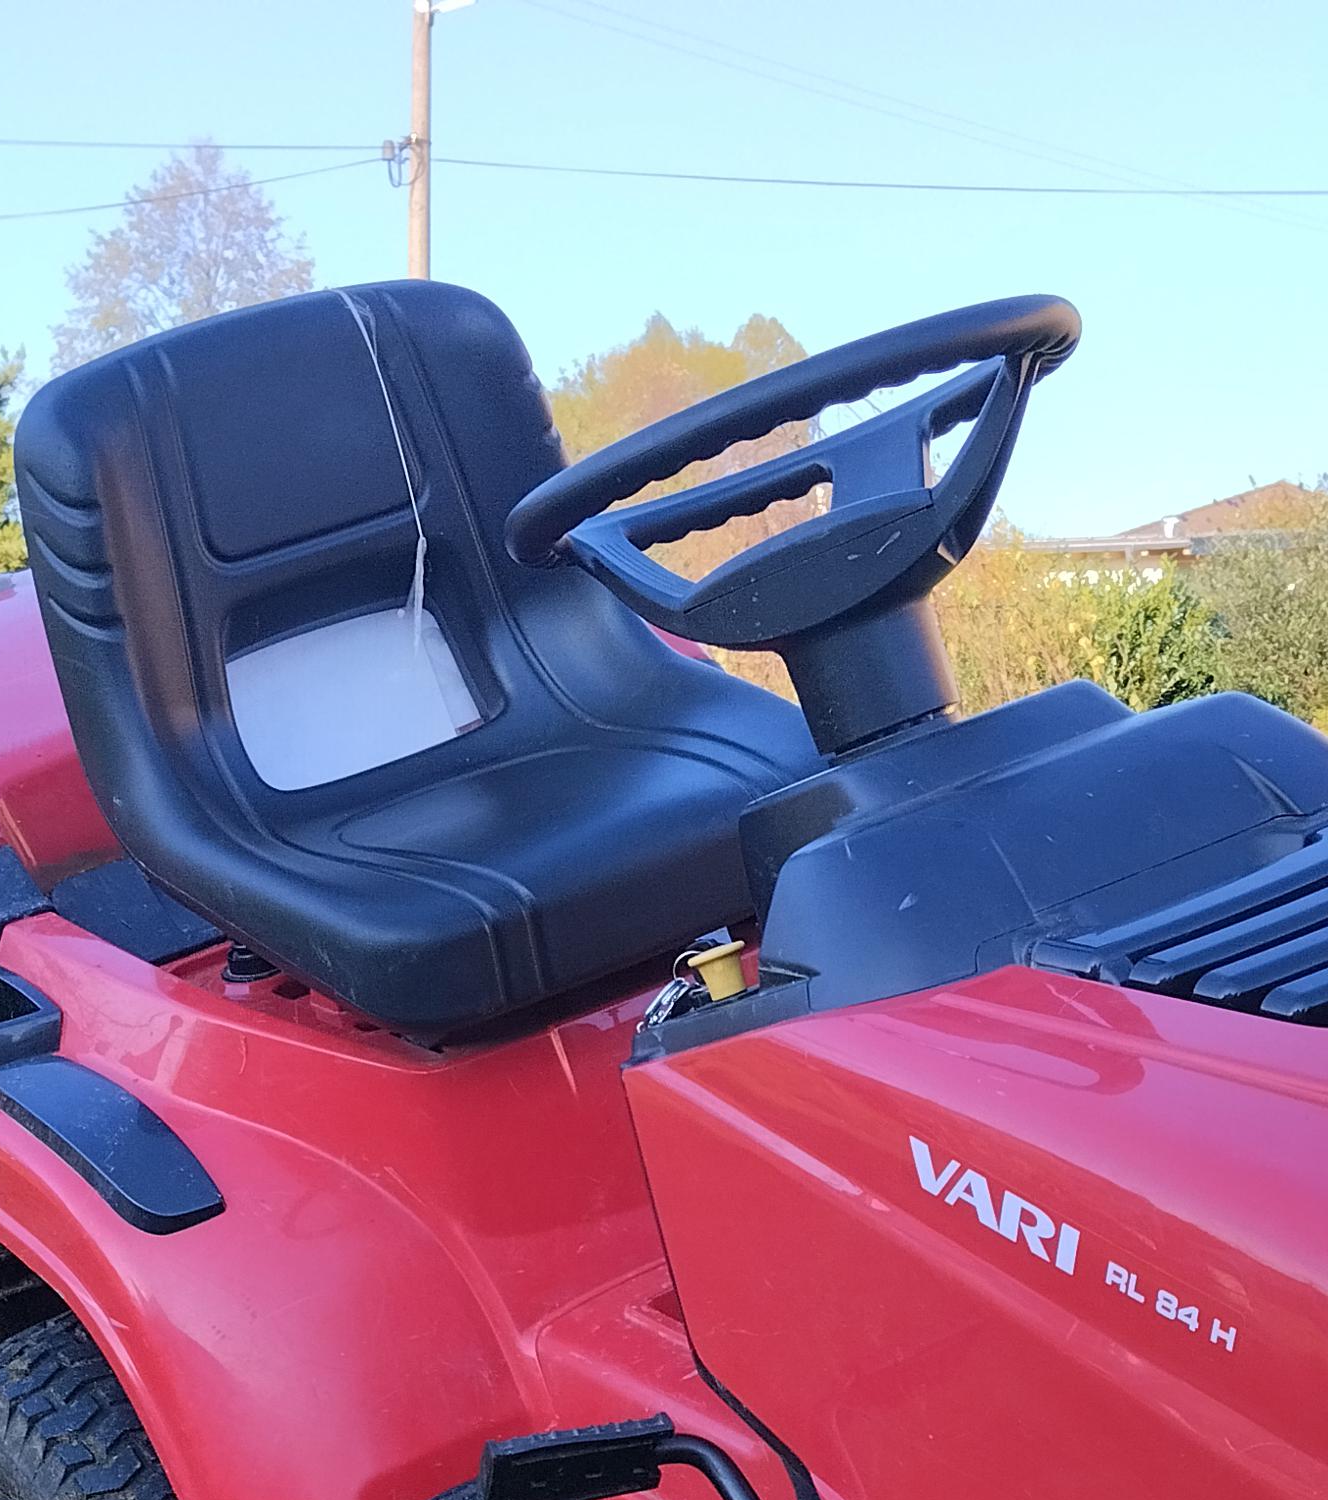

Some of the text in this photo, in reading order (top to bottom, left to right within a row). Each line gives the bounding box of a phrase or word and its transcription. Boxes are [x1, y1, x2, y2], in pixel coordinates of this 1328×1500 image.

[908, 1134, 1238, 1353] VARI RL 84 H
